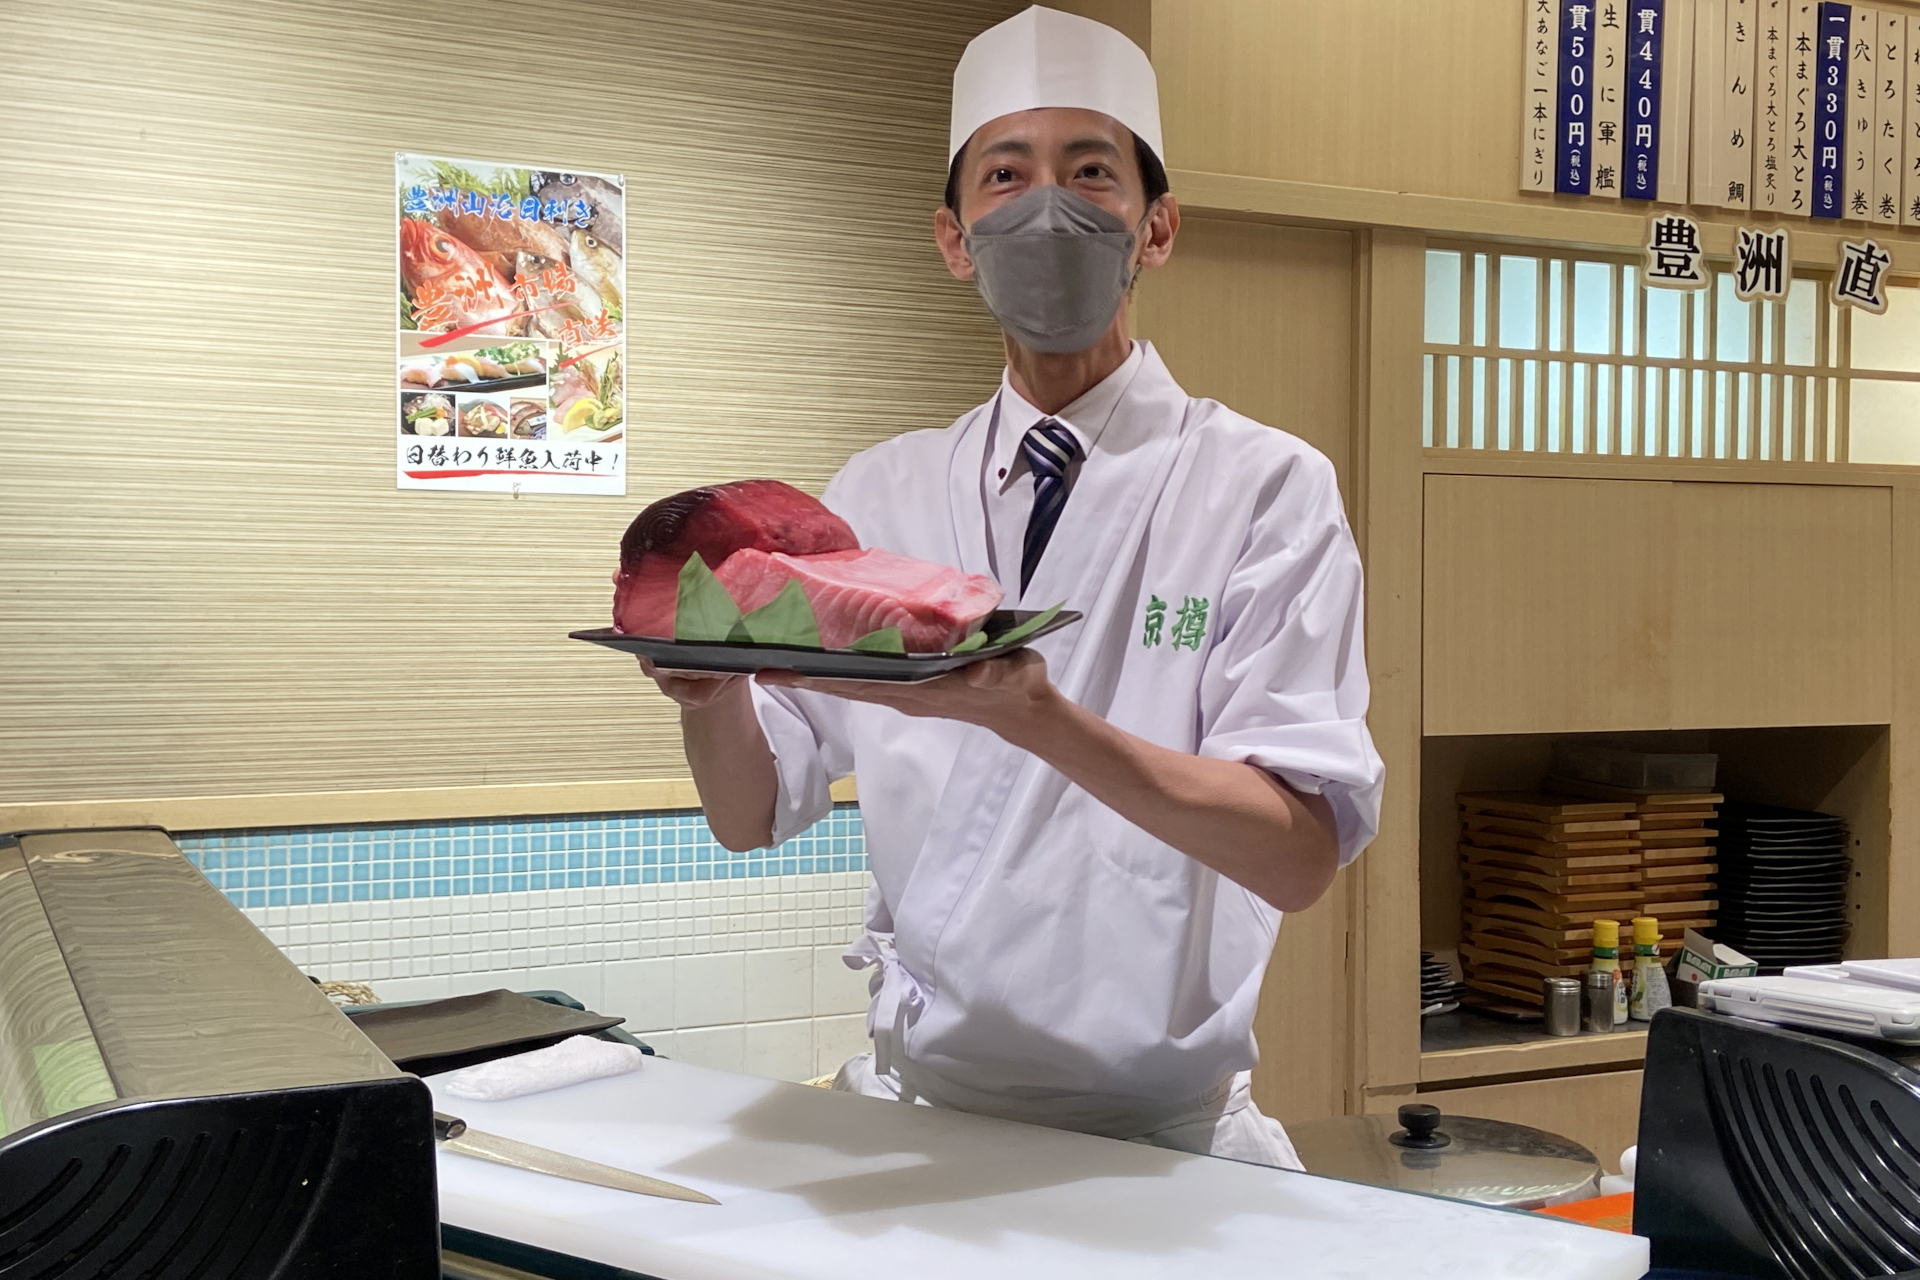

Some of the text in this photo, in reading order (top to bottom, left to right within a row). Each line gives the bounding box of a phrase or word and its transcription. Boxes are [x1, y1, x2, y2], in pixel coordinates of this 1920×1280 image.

[1595, 3, 1620, 190] 生うに軍艦
[1727, 21, 1747, 204] きんめ鯛
[1764, 26, 1780, 207] 本まぐろ大とろ塩炙り
[1791, 31, 1812, 210] 本まぐろ大とろ
[1851, 39, 1871, 215] 穴きゅう巻
[1878, 43, 1897, 219] とろたく巻
[557, 308, 617, 352] 直送
[1143, 594, 1209, 651] 京樽
